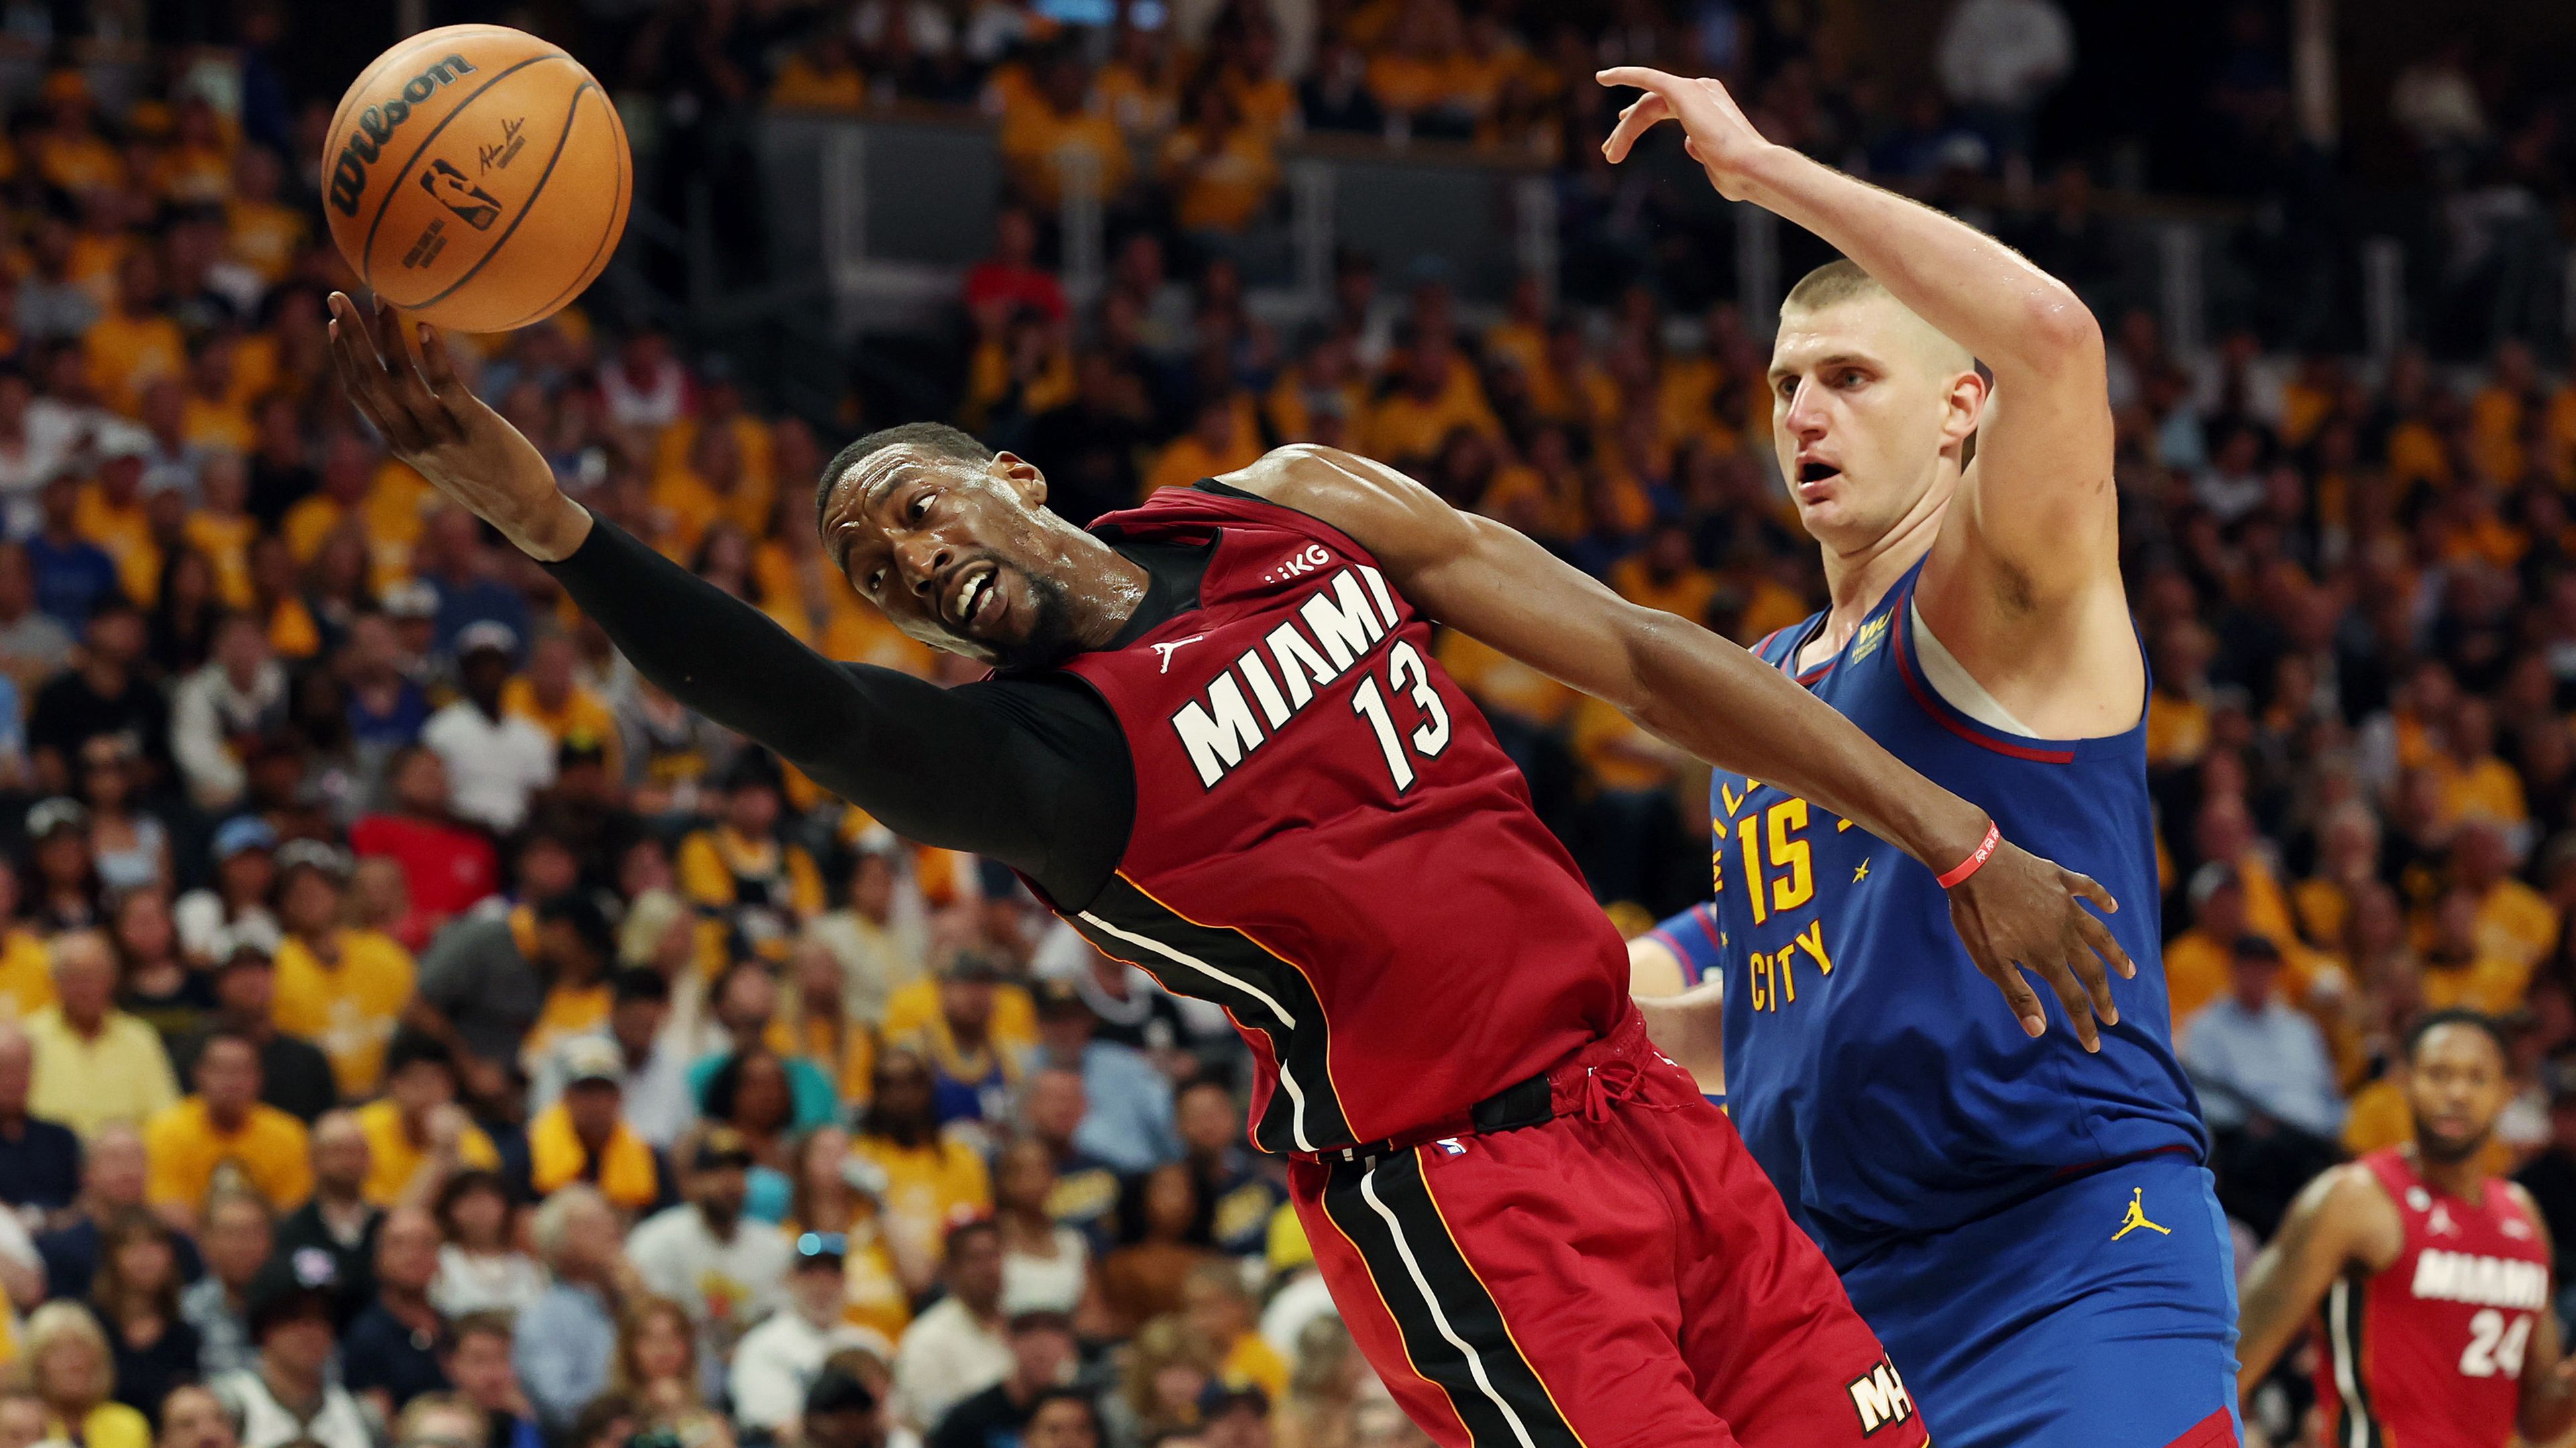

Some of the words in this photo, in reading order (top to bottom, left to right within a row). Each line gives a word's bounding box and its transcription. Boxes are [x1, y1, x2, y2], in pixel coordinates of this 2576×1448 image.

[330, 54, 479, 219] Wilson
[1169, 562, 1403, 791] MIAMI
[1348, 636, 1451, 797] 13
[1737, 795, 1815, 927] 15
[1750, 917, 1833, 1014] CITY
[2459, 1308, 2533, 1380] 24
